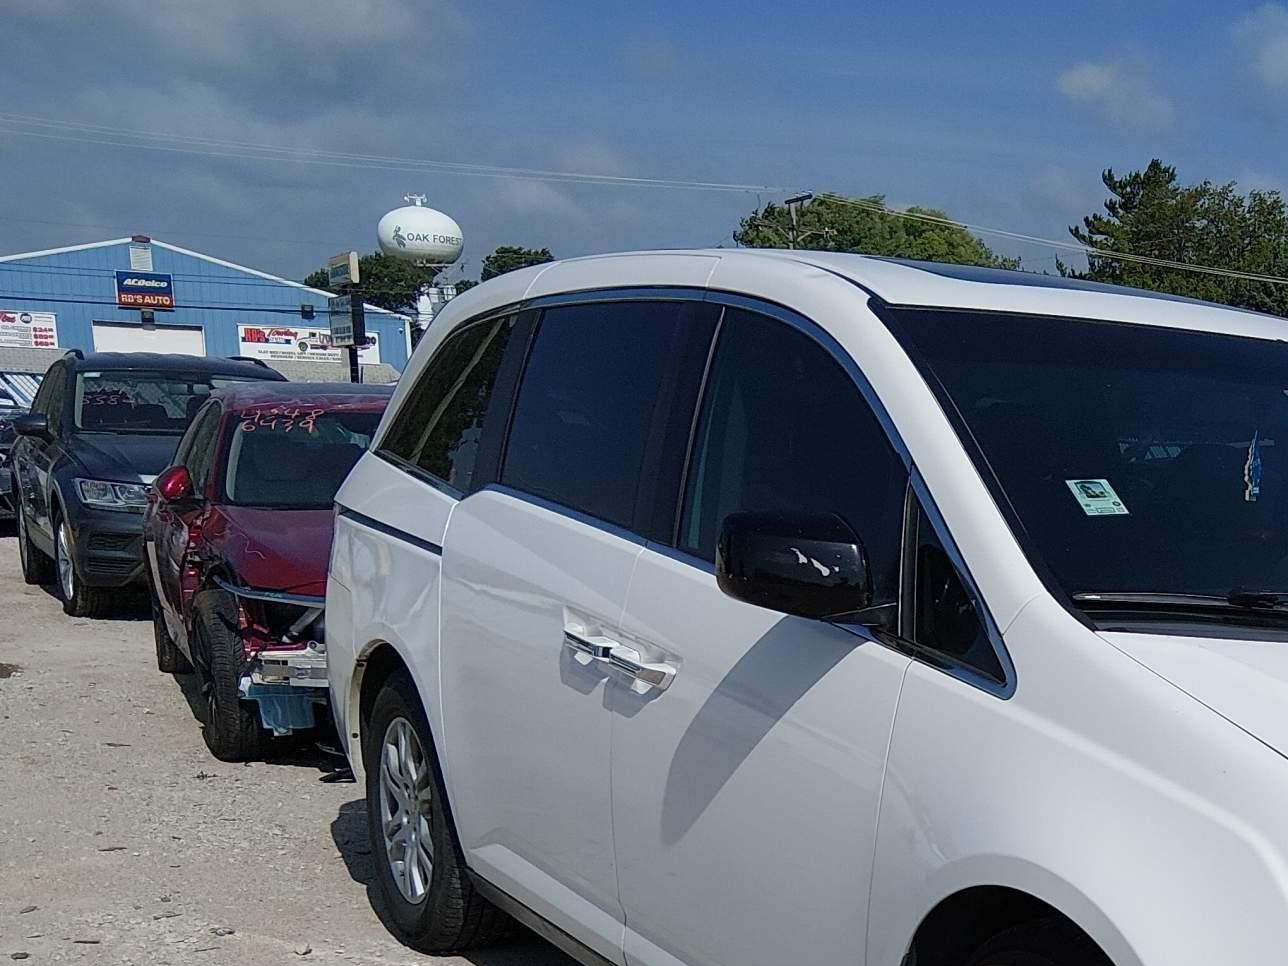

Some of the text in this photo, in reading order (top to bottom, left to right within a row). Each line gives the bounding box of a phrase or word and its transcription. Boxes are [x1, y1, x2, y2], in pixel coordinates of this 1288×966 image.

[407, 233, 463, 246] OAK FOREST
[123, 279, 168, 288] ACDelco
[144, 296, 170, 305] AUTO
